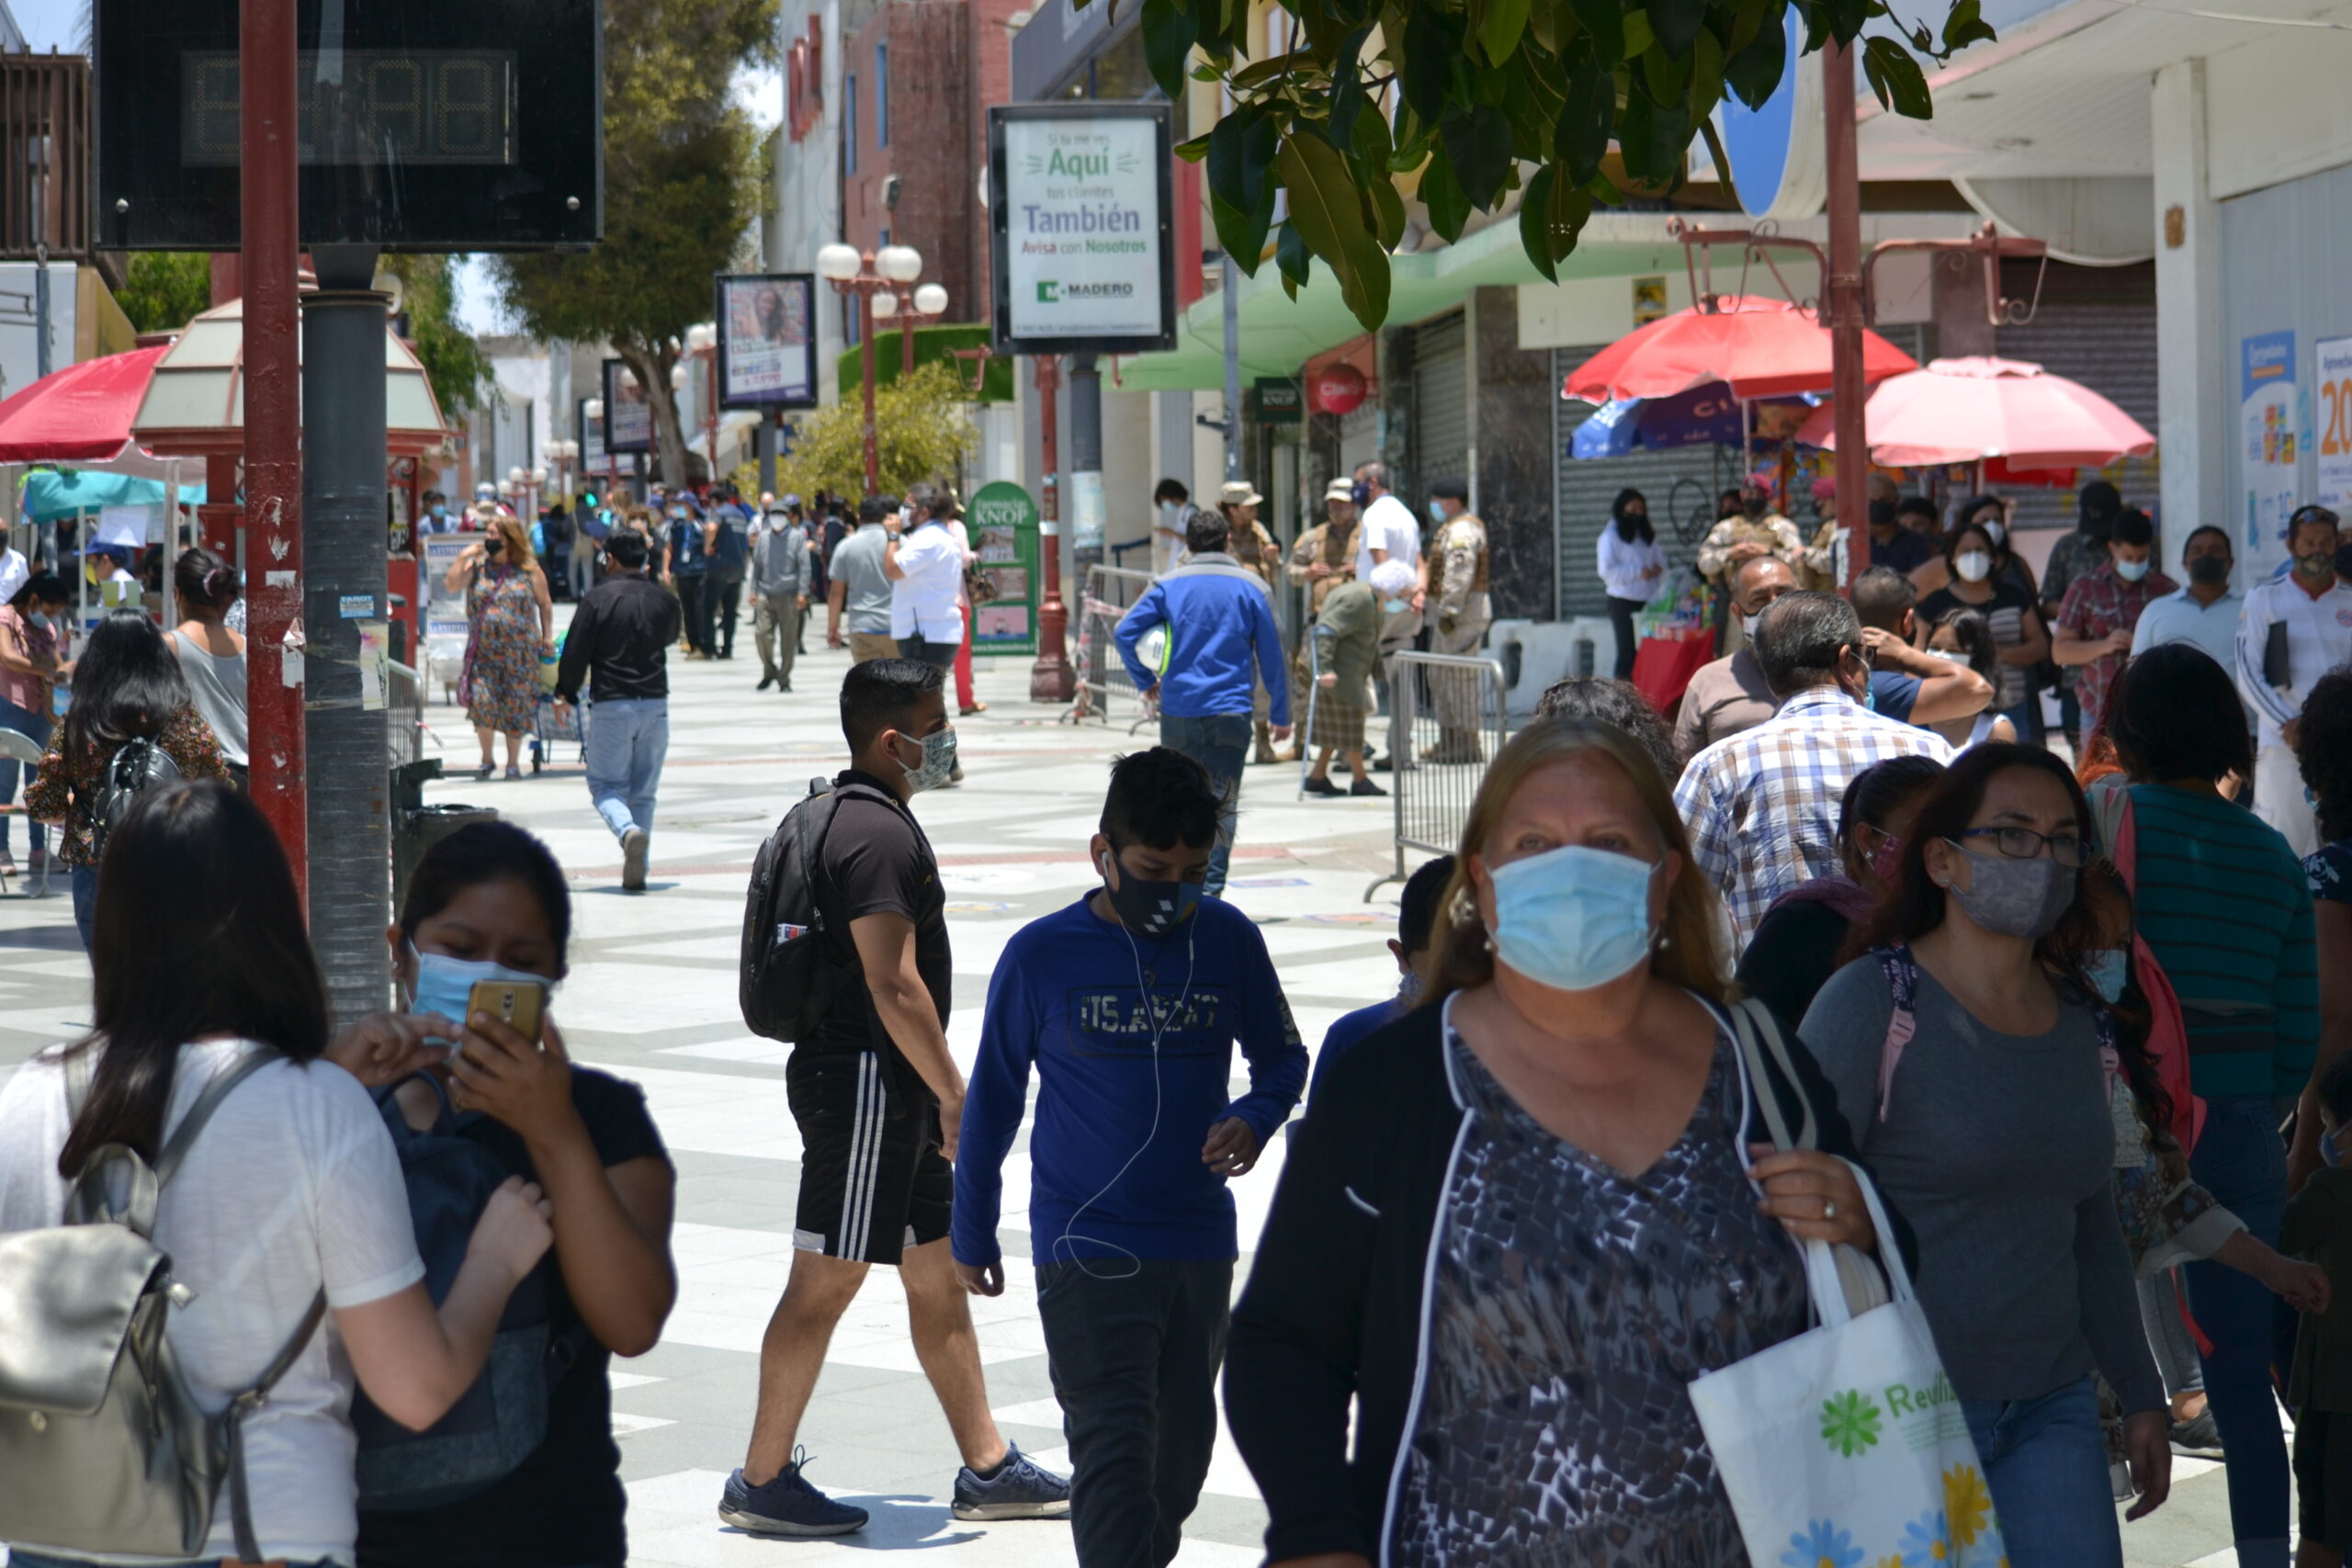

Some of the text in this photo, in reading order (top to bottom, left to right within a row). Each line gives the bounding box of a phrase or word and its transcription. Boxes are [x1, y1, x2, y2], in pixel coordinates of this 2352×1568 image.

[1047, 147, 1109, 182] Aquí
[1046, 186, 1114, 198] tus clientes
[1022, 202, 1140, 233] También
[1022, 239, 1147, 254] Avisa con Nosotros
[1069, 283, 1134, 296] MADERO
[976, 509, 1028, 525] KNOP
